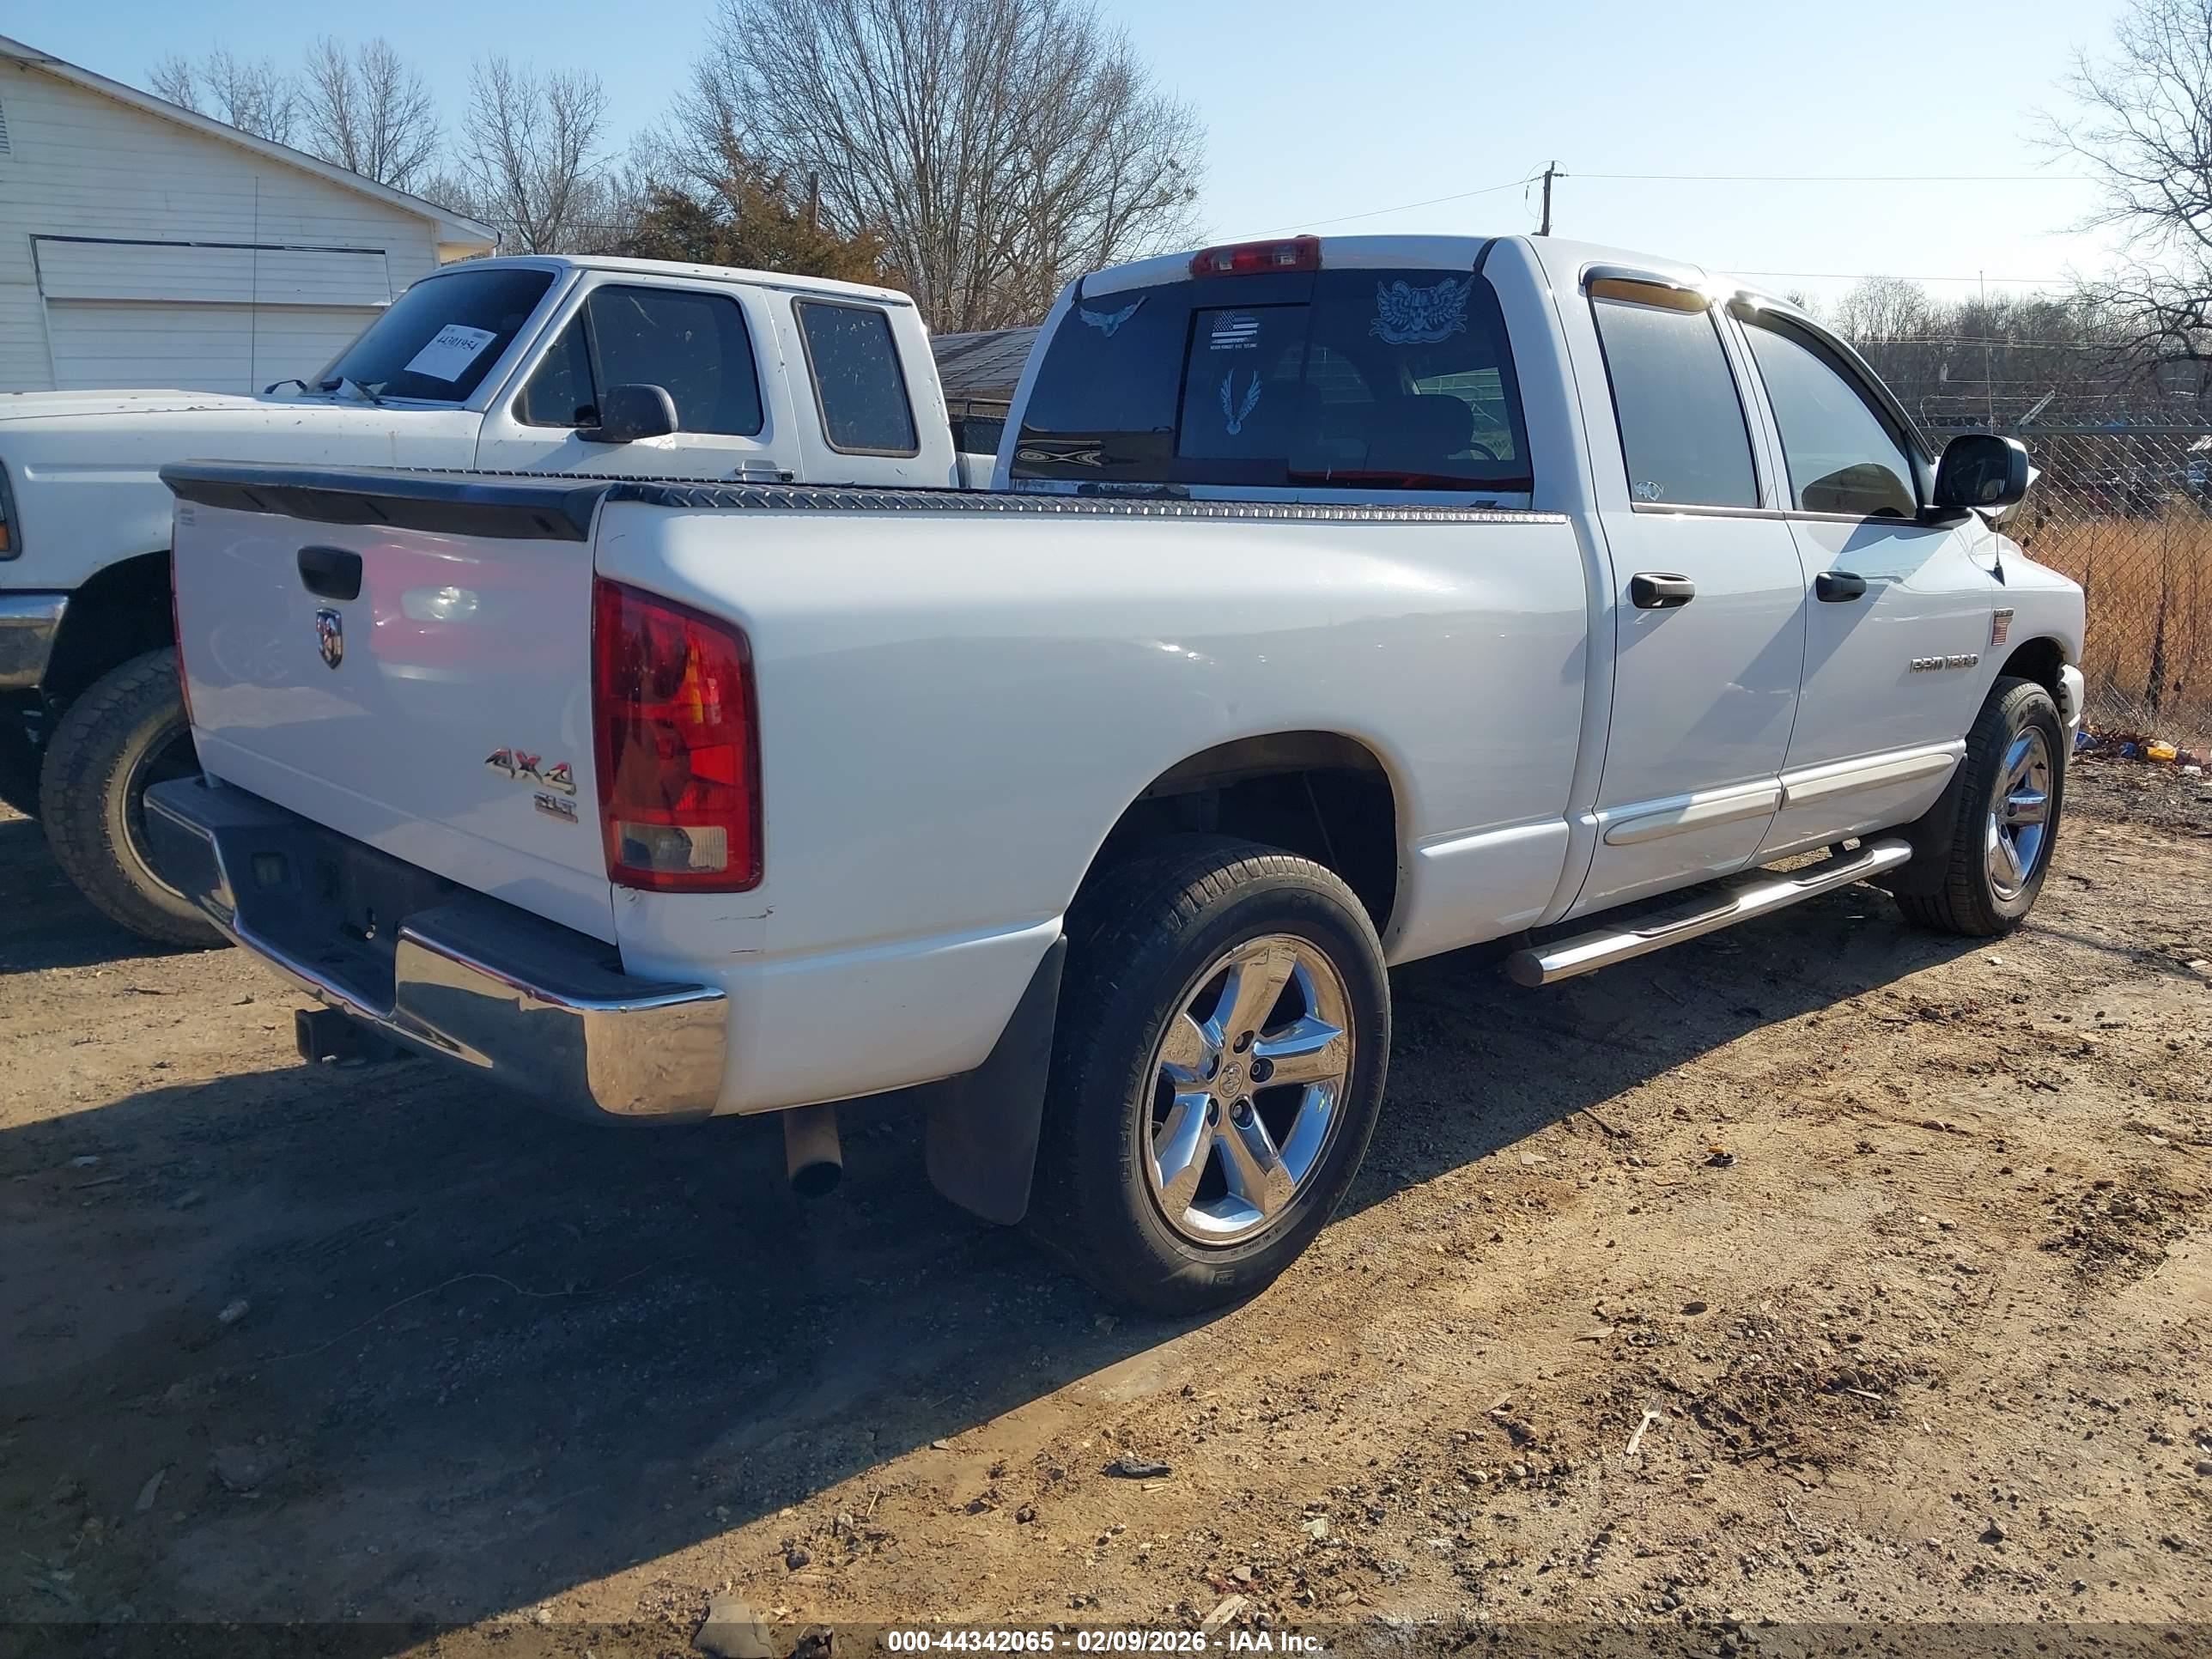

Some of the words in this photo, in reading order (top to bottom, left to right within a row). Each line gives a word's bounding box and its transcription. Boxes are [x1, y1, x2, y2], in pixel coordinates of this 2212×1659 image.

[1910, 656, 1945, 673] RAM
[1945, 653, 1979, 672] 1500
[533, 791, 578, 823] SLT
